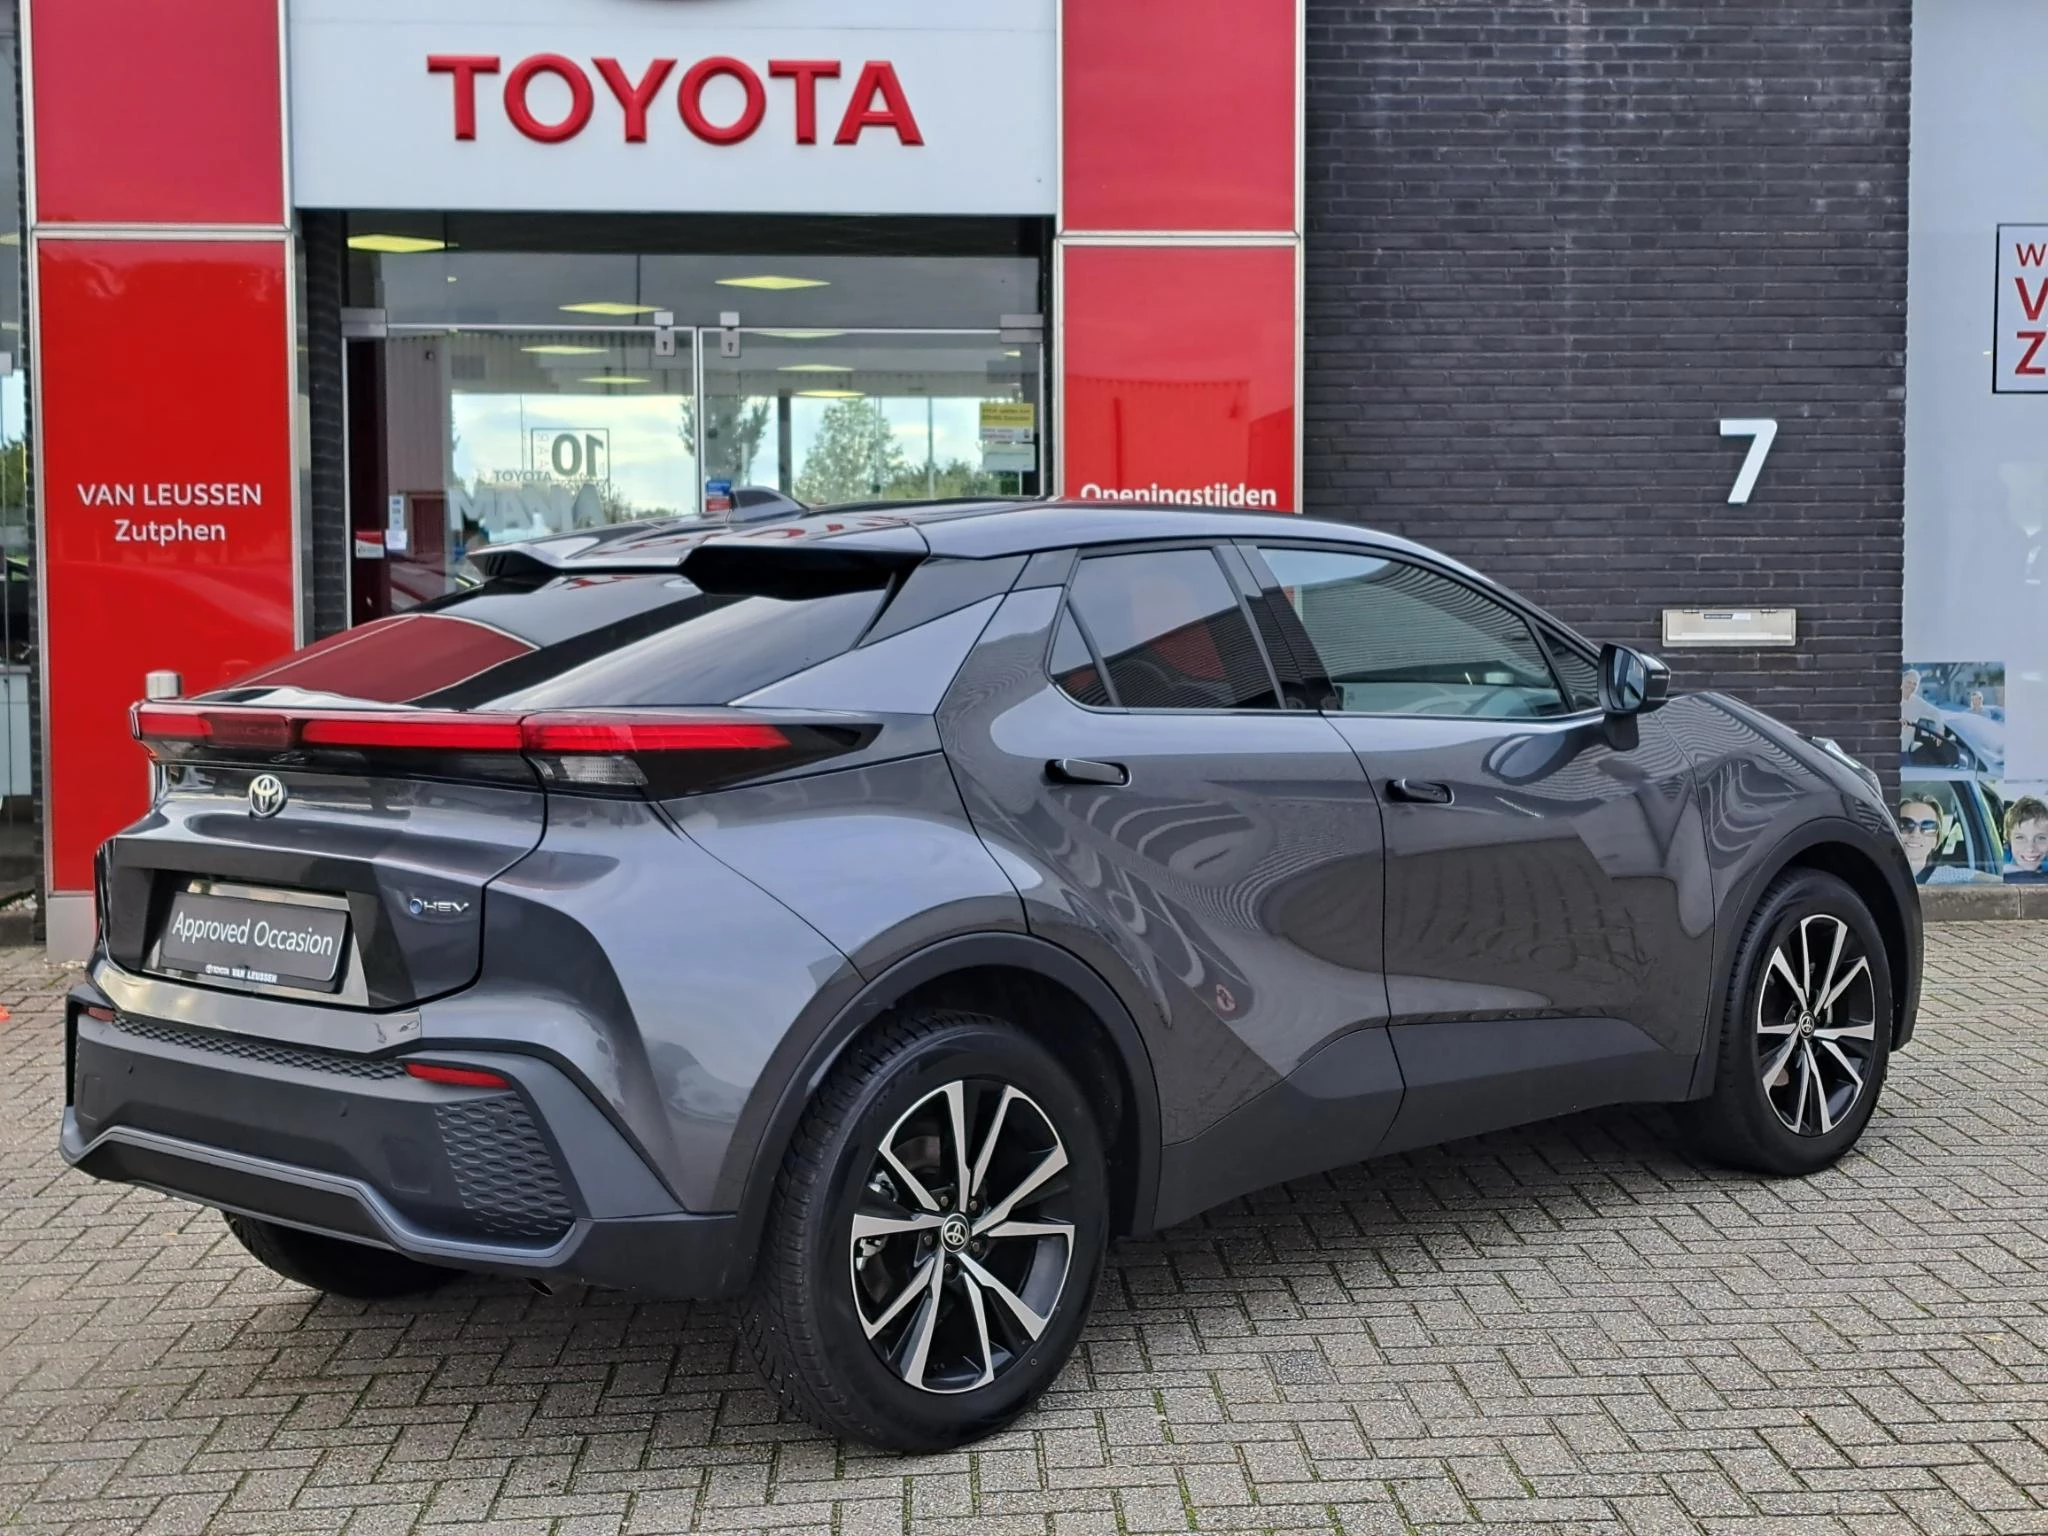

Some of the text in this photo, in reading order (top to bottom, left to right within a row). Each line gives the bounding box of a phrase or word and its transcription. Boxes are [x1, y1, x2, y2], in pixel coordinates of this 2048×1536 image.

[426, 52, 925, 147] TOYOTA
[1720, 418, 1778, 504] 7
[493, 470, 552, 482] TOYOTA
[77, 483, 262, 507] VAN LEUSSEN
[114, 518, 226, 547] Zutphen
[423, 901, 470, 912] HEV
[172, 911, 333, 956] Approved Occasion
